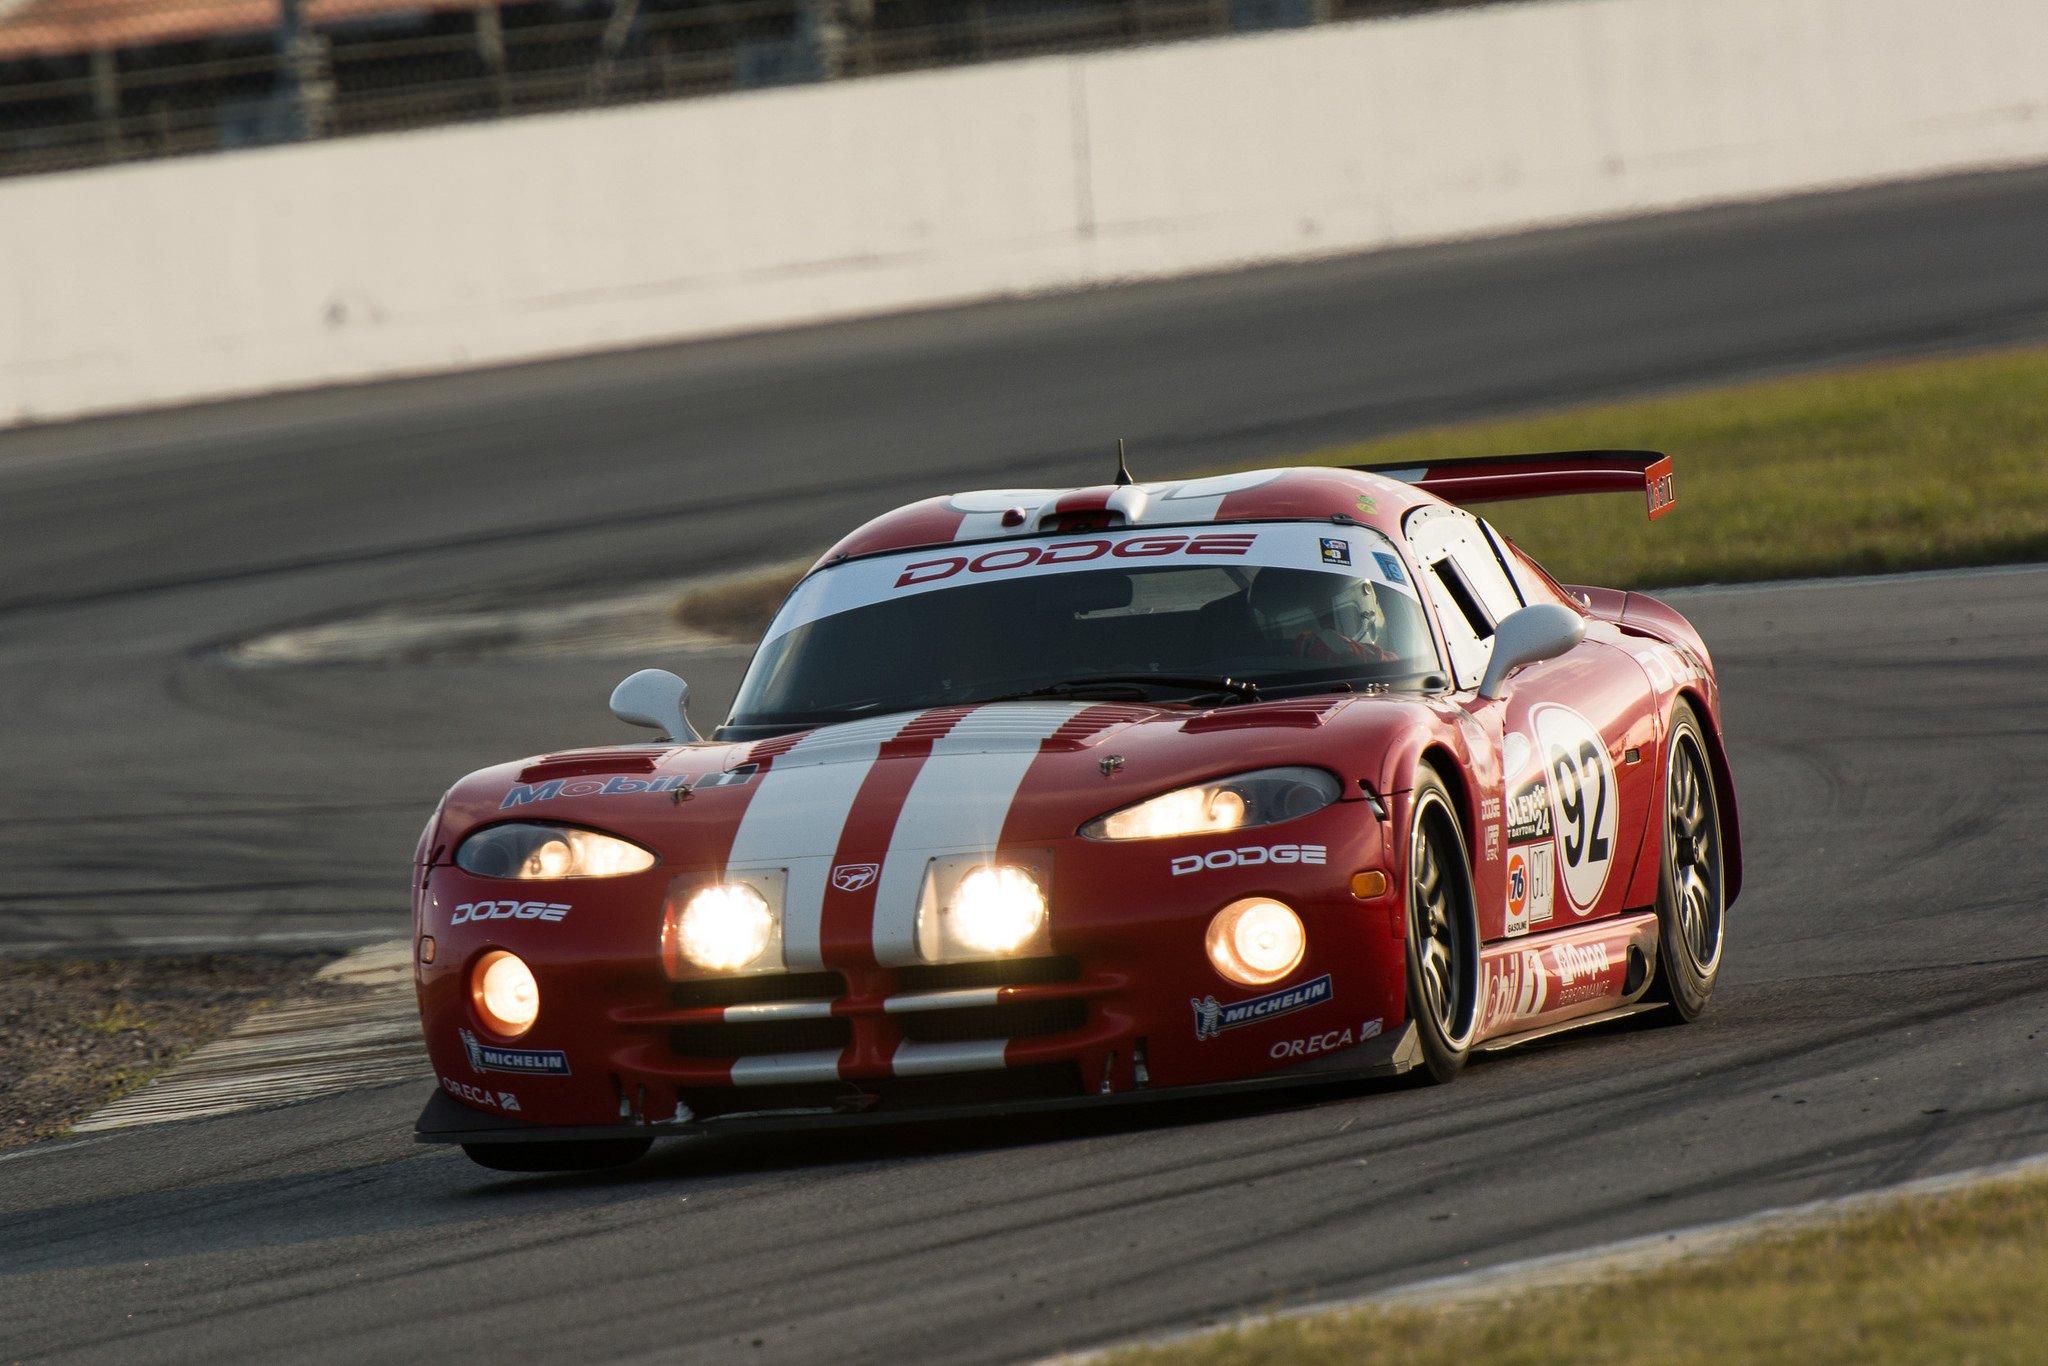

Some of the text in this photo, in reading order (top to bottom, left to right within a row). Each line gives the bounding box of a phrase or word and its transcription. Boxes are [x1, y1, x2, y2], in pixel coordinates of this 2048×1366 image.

[894, 534, 1258, 588] DODGE
[499, 775, 690, 810] Mobil
[1552, 740, 1609, 868] 92
[1507, 793, 1537, 829] OLEX
[1536, 807, 1550, 836] 24
[1511, 823, 1536, 838] DAYTONA
[1171, 844, 1327, 876] DODGE
[1510, 866, 1525, 901] 76
[451, 900, 573, 925] DODGE
[1507, 920, 1528, 934] GASOLINE
[1225, 982, 1328, 1024] MICHELIN
[1560, 979, 1611, 1005] PERFORMANCE
[1270, 1028, 1353, 1059] ORECA
[484, 1051, 563, 1069] MICHELIN
[443, 1077, 497, 1107] ORECA
